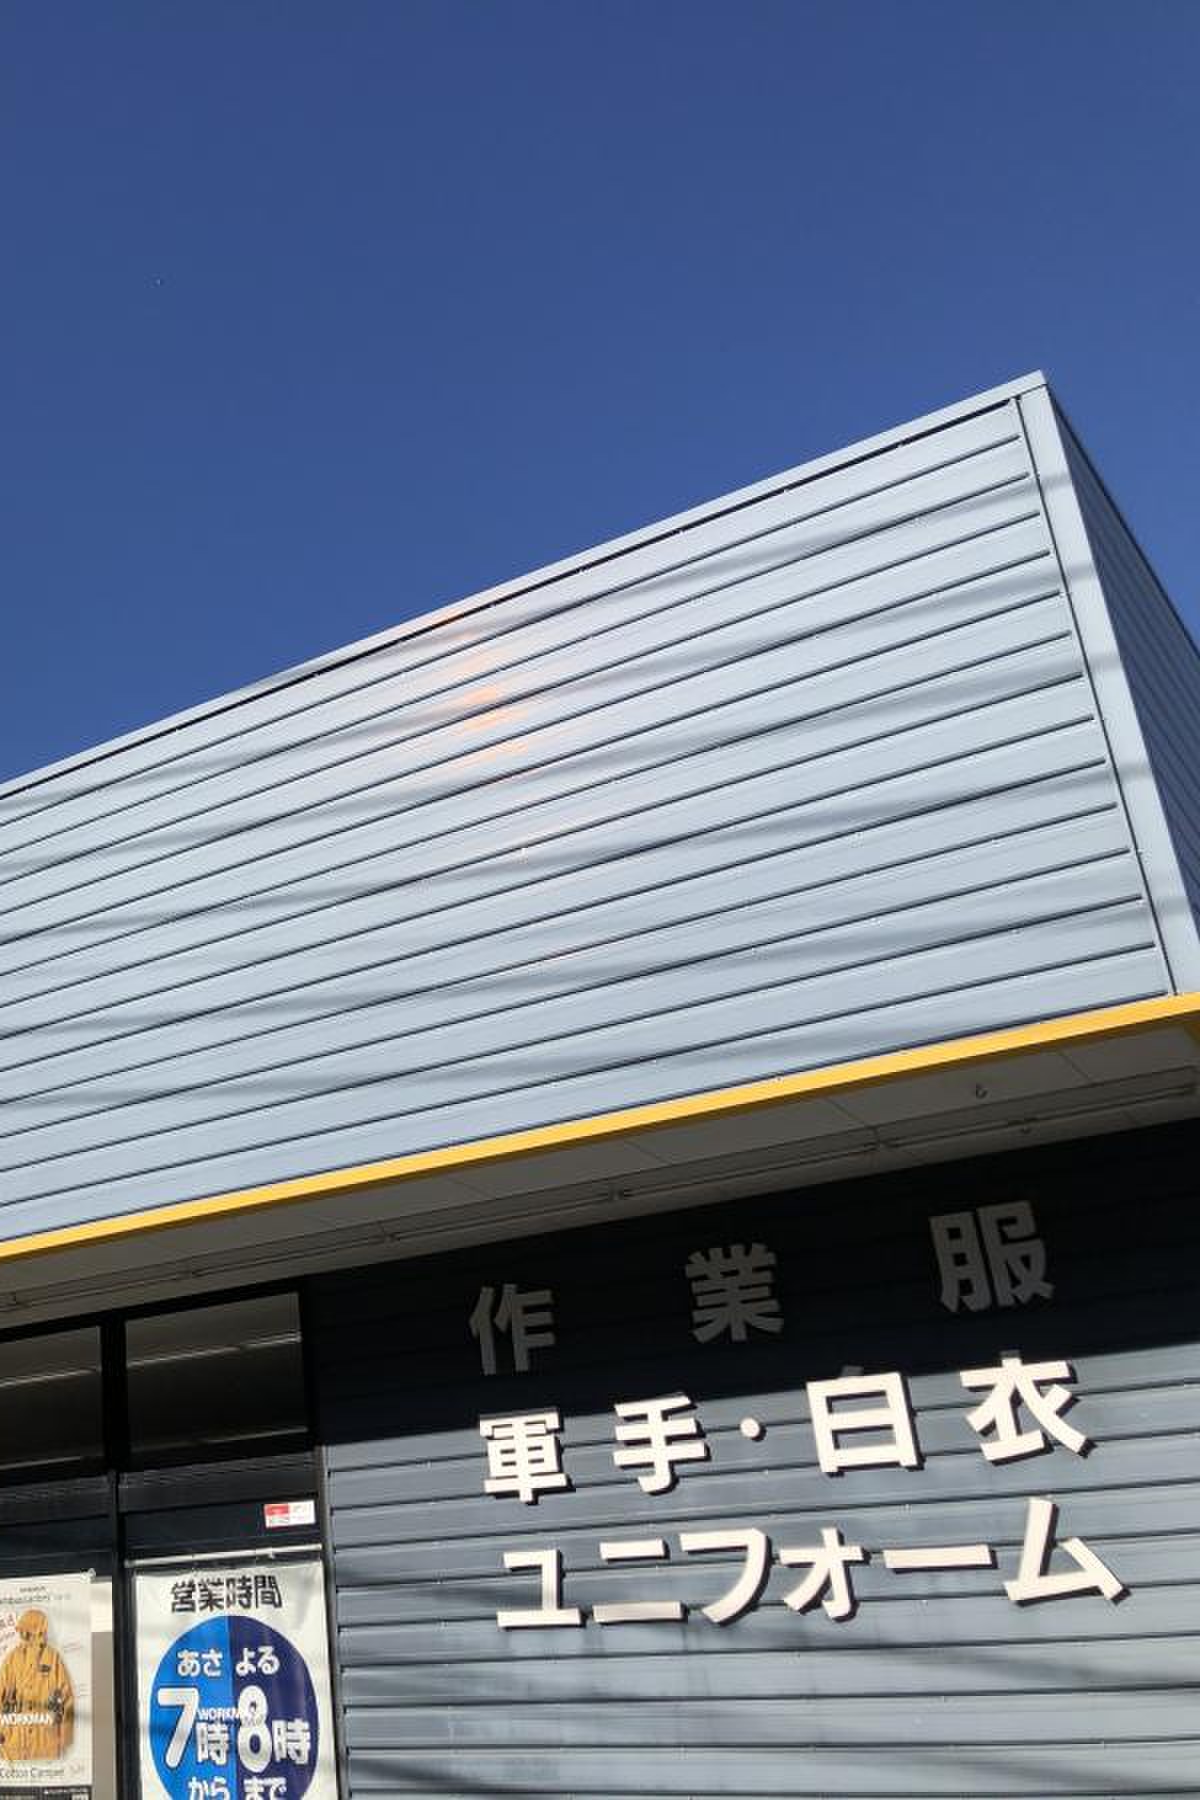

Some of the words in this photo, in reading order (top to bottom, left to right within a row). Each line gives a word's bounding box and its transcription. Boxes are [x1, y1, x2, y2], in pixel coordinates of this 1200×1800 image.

[469, 1202, 1054, 1375] 作業服
[497, 1498, 1130, 1629] ユニフォーム
[171, 1575, 282, 1613] 営業時間
[177, 1649, 223, 1677] あさ
[236, 1646, 280, 1676] よる
[0, 1711, 55, 1726] WORKMAN
[158, 1687, 230, 1768] 7時
[238, 1685, 311, 1773] 8時
[188, 1776, 230, 1800] から
[244, 1777, 287, 1800] まで
